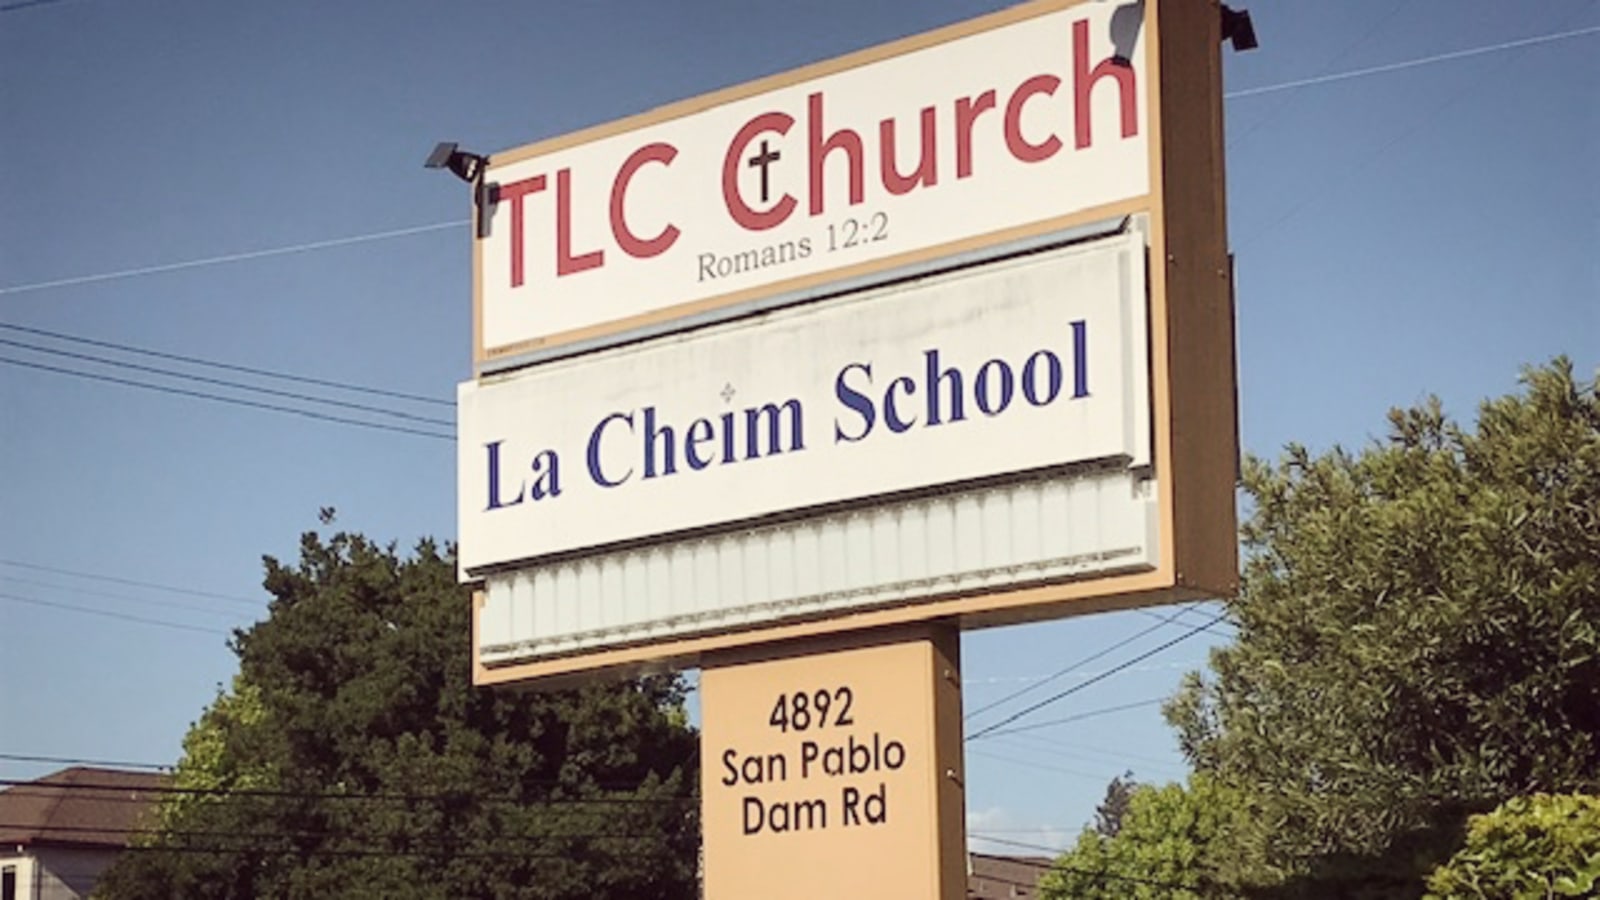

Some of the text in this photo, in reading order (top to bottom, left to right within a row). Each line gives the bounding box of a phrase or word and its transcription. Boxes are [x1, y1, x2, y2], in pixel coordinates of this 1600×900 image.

[496, 18, 1139, 288] TLC Church
[697, 211, 889, 283] Romans 12:2
[483, 320, 1092, 511] La Cheim School
[769, 687, 853, 733] 4892
[722, 732, 906, 786] San Pablo
[742, 783, 886, 836] Dam Rd
